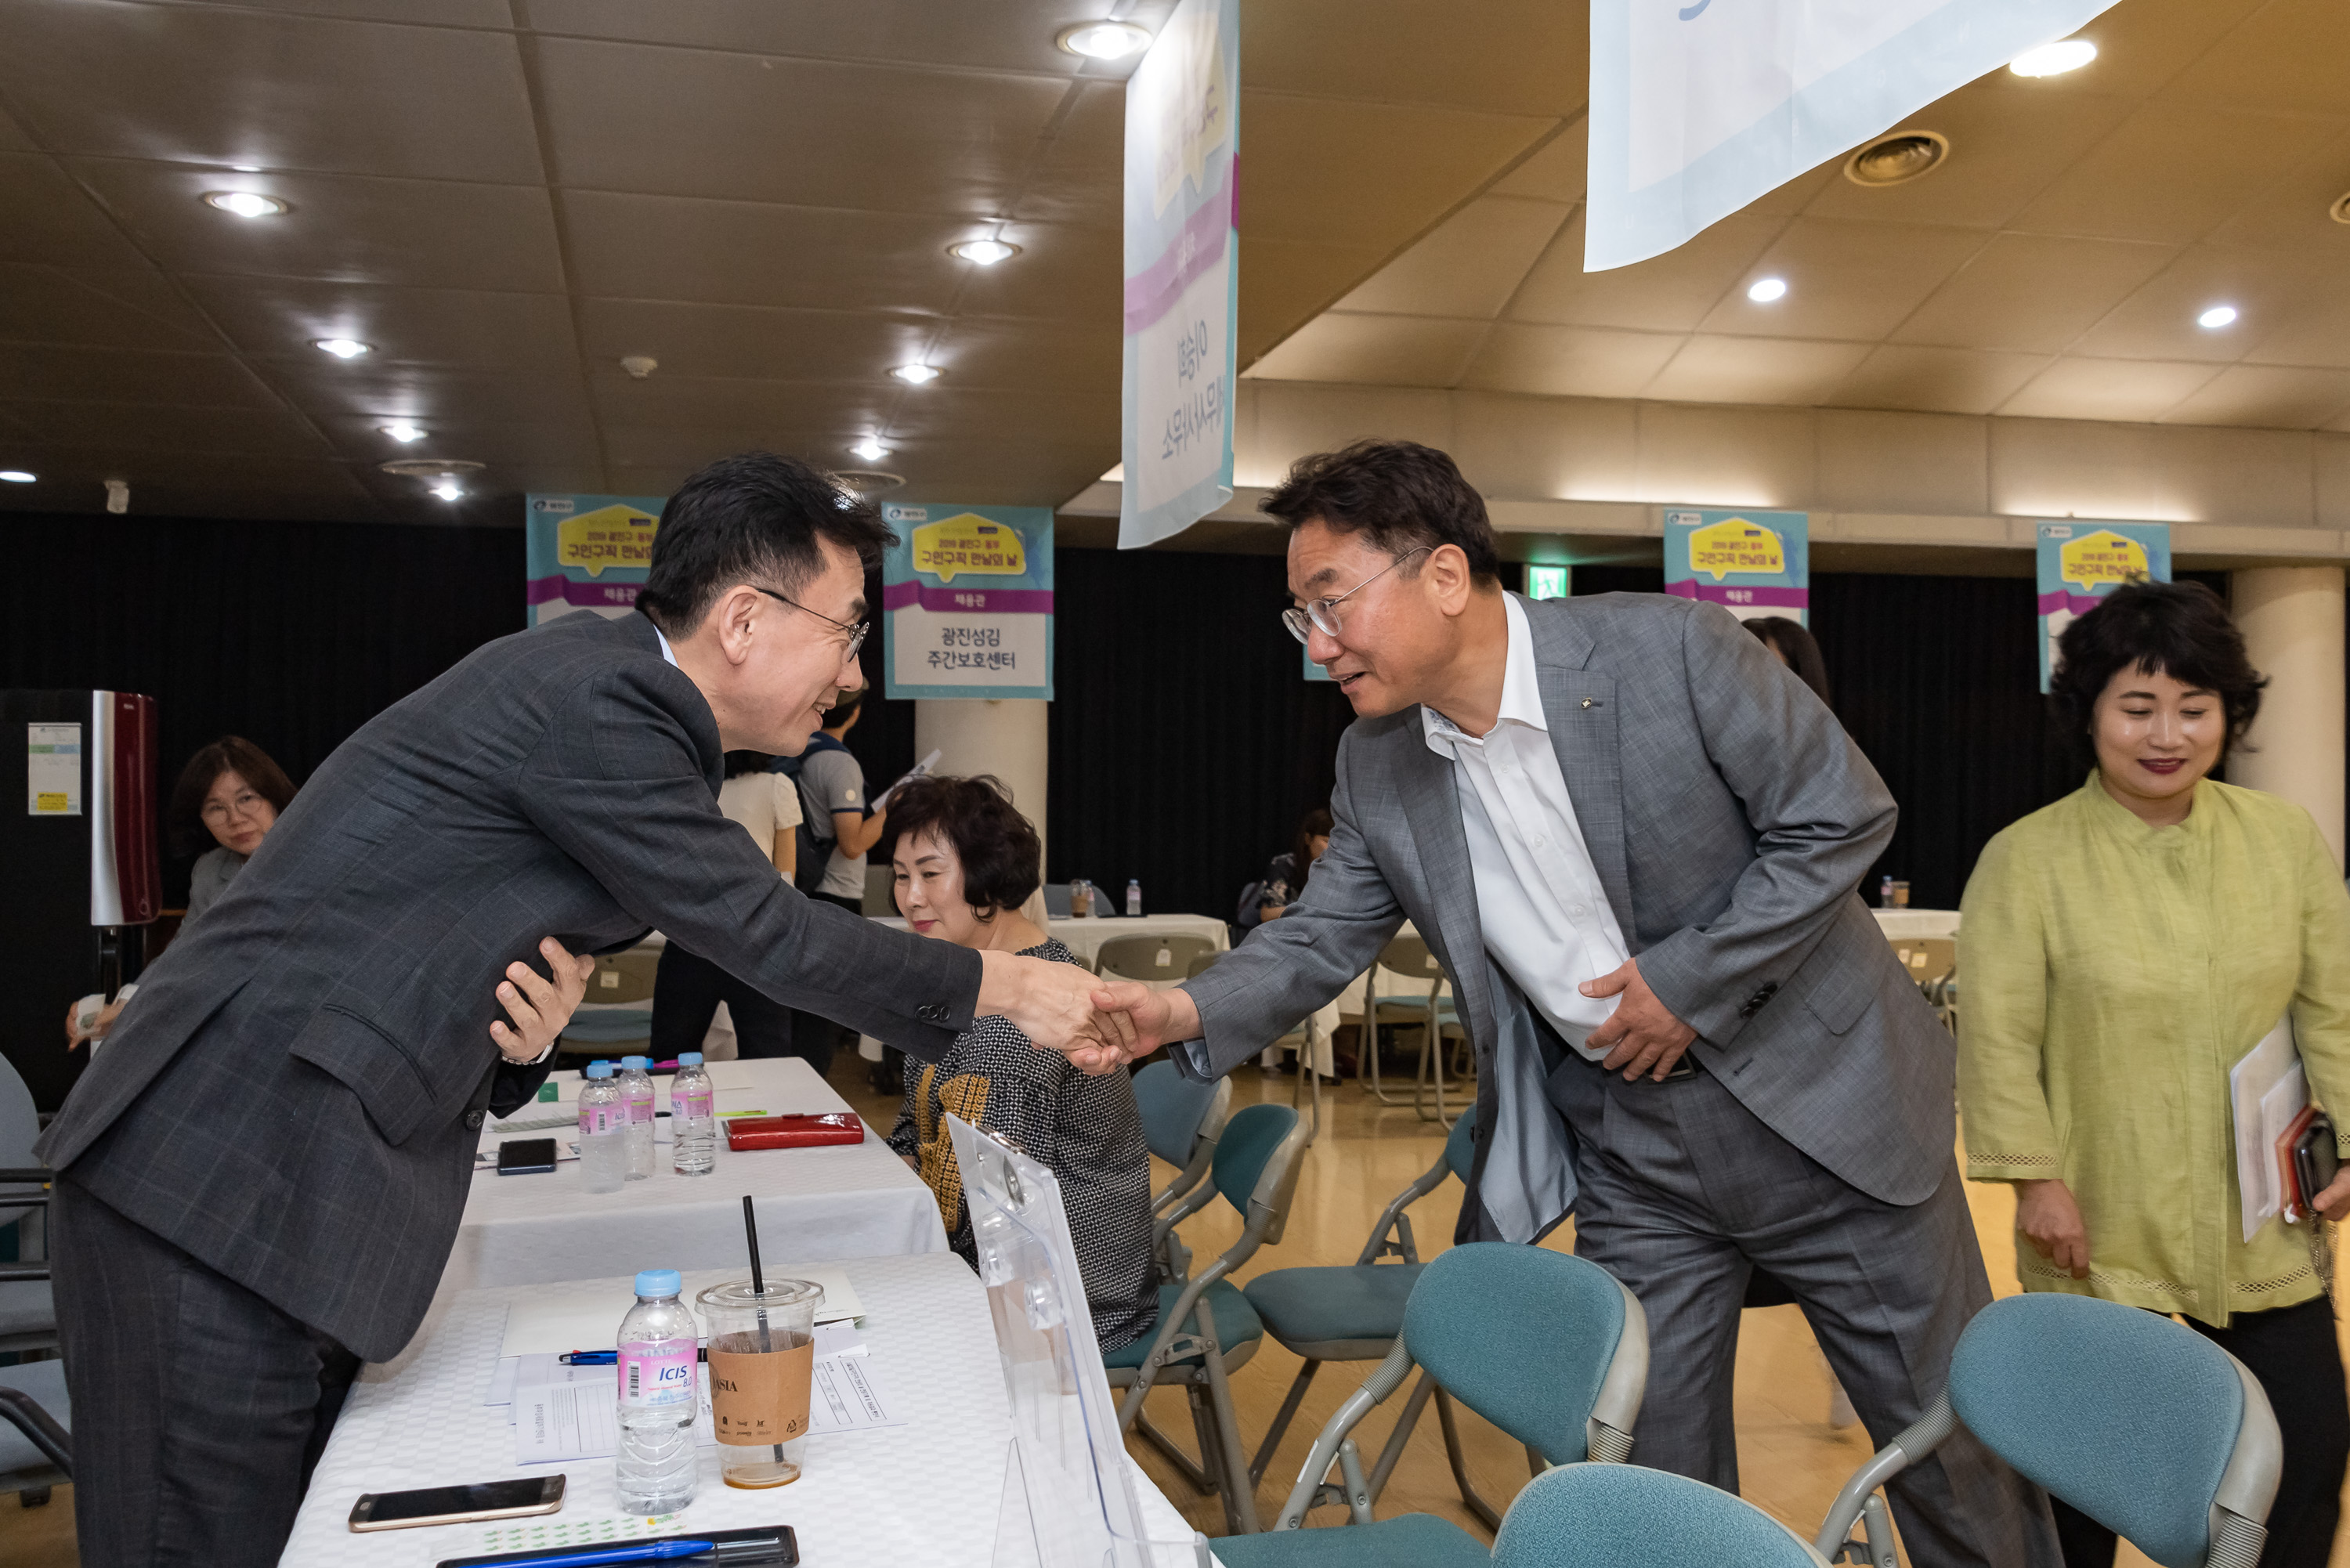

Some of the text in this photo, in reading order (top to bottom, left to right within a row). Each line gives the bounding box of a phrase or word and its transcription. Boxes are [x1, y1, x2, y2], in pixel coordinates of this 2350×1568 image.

[568, 544, 618, 559] 구인구직
[921, 550, 1018, 567] 구인구직 만남의 날
[1697, 551, 1736, 565] 구인구직
[941, 627, 1000, 648] 광진섬김
[927, 650, 1016, 670] 주간보호센터
[659, 1365, 688, 1382] ICIS
[682, 1376, 692, 1388] 8.0
